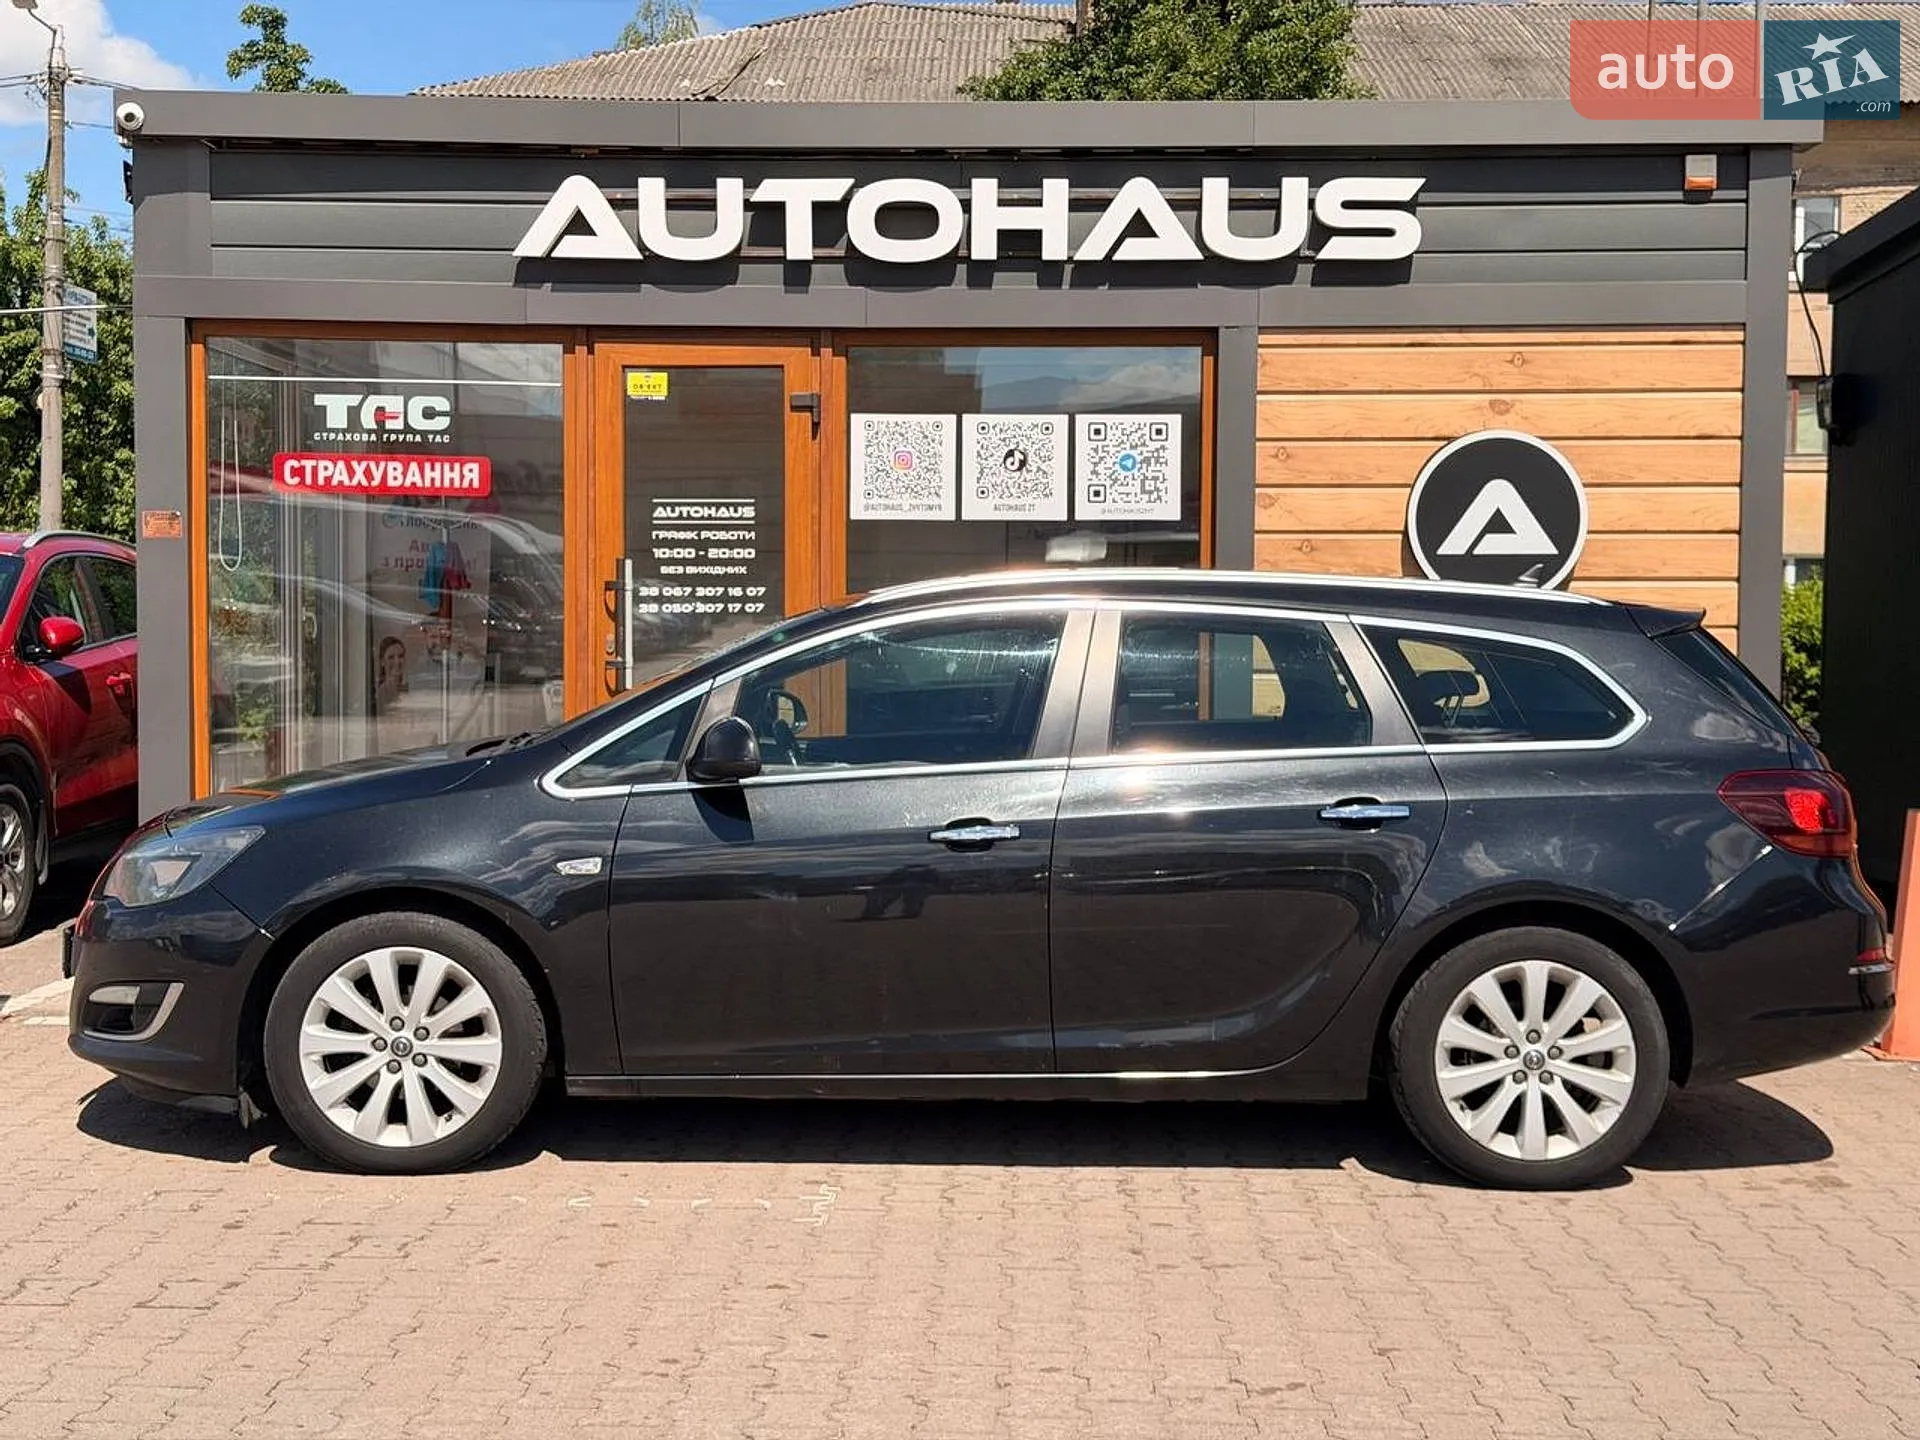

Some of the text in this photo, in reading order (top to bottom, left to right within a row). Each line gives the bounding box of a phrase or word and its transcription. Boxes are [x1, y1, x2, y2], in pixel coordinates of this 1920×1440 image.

[513, 174, 1426, 263] AUTOHAUS
[313, 431, 378, 442] СТРАХОВА
[382, 432, 422, 443] ГРУПА
[283, 458, 481, 489] СТРАХУВАННЯ
[652, 506, 756, 518] AUTOHAUS
[700, 531, 756, 540] РОБОТИ
[652, 548, 696, 559] 10:00
[707, 548, 756, 559] 20:00
[662, 586, 693, 597] 067
[695, 586, 725, 597] 307
[746, 586, 767, 597] 07
[727, 603, 742, 613] 17
[744, 603, 765, 613] 07
